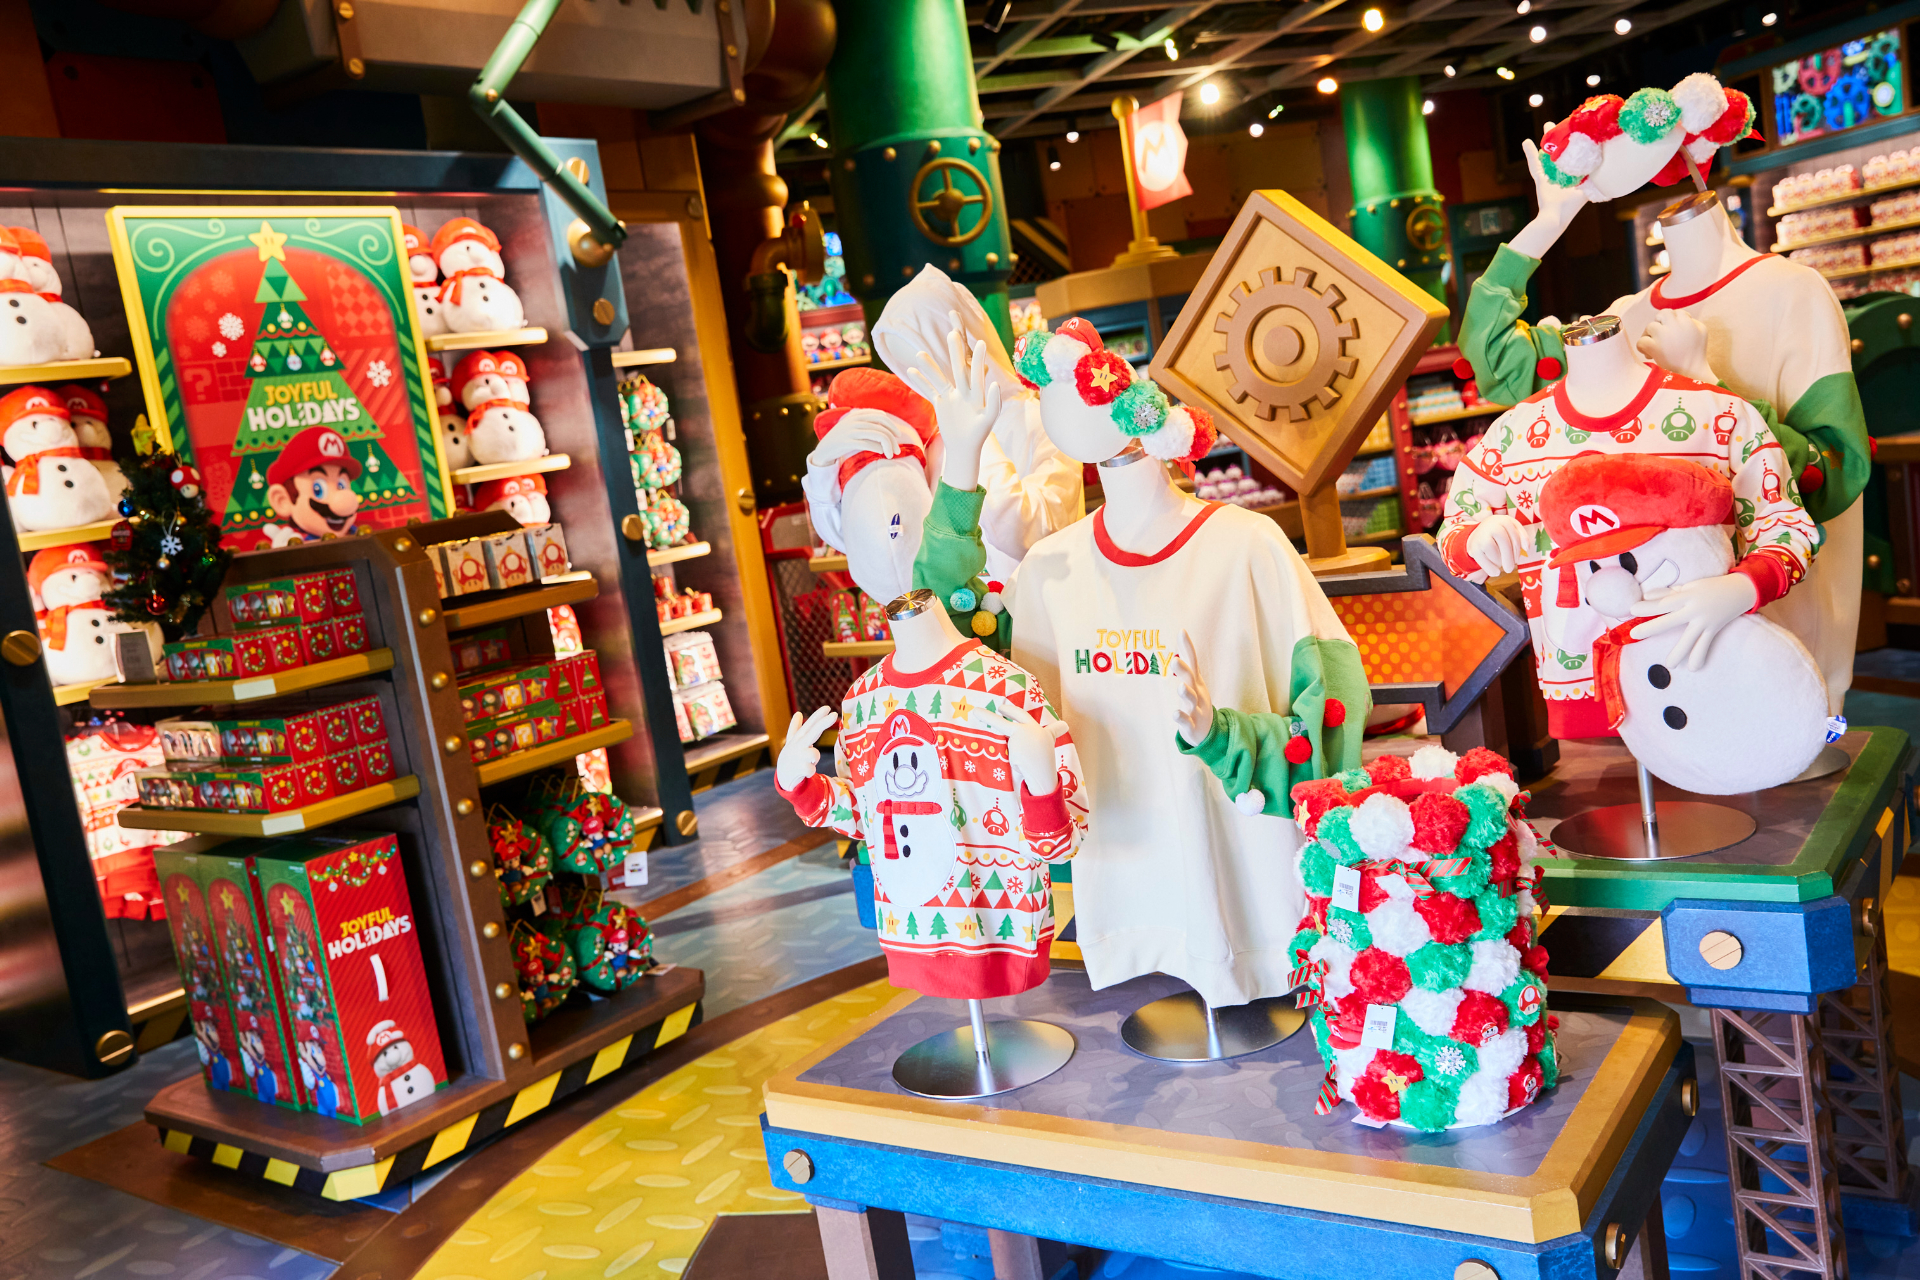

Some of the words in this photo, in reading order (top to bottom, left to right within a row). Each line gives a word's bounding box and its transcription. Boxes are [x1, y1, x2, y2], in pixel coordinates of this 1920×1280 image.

[264, 380, 338, 406] JOYFUL
[247, 397, 360, 432] HOLIDAYS
[1578, 508, 1616, 535] M
[1095, 628, 1167, 650] JOYFUL
[1074, 648, 1180, 677] HOLIDAY
[892, 718, 909, 738] M
[340, 906, 395, 938] JOYFUL
[327, 914, 412, 960] HOLIDAYS
